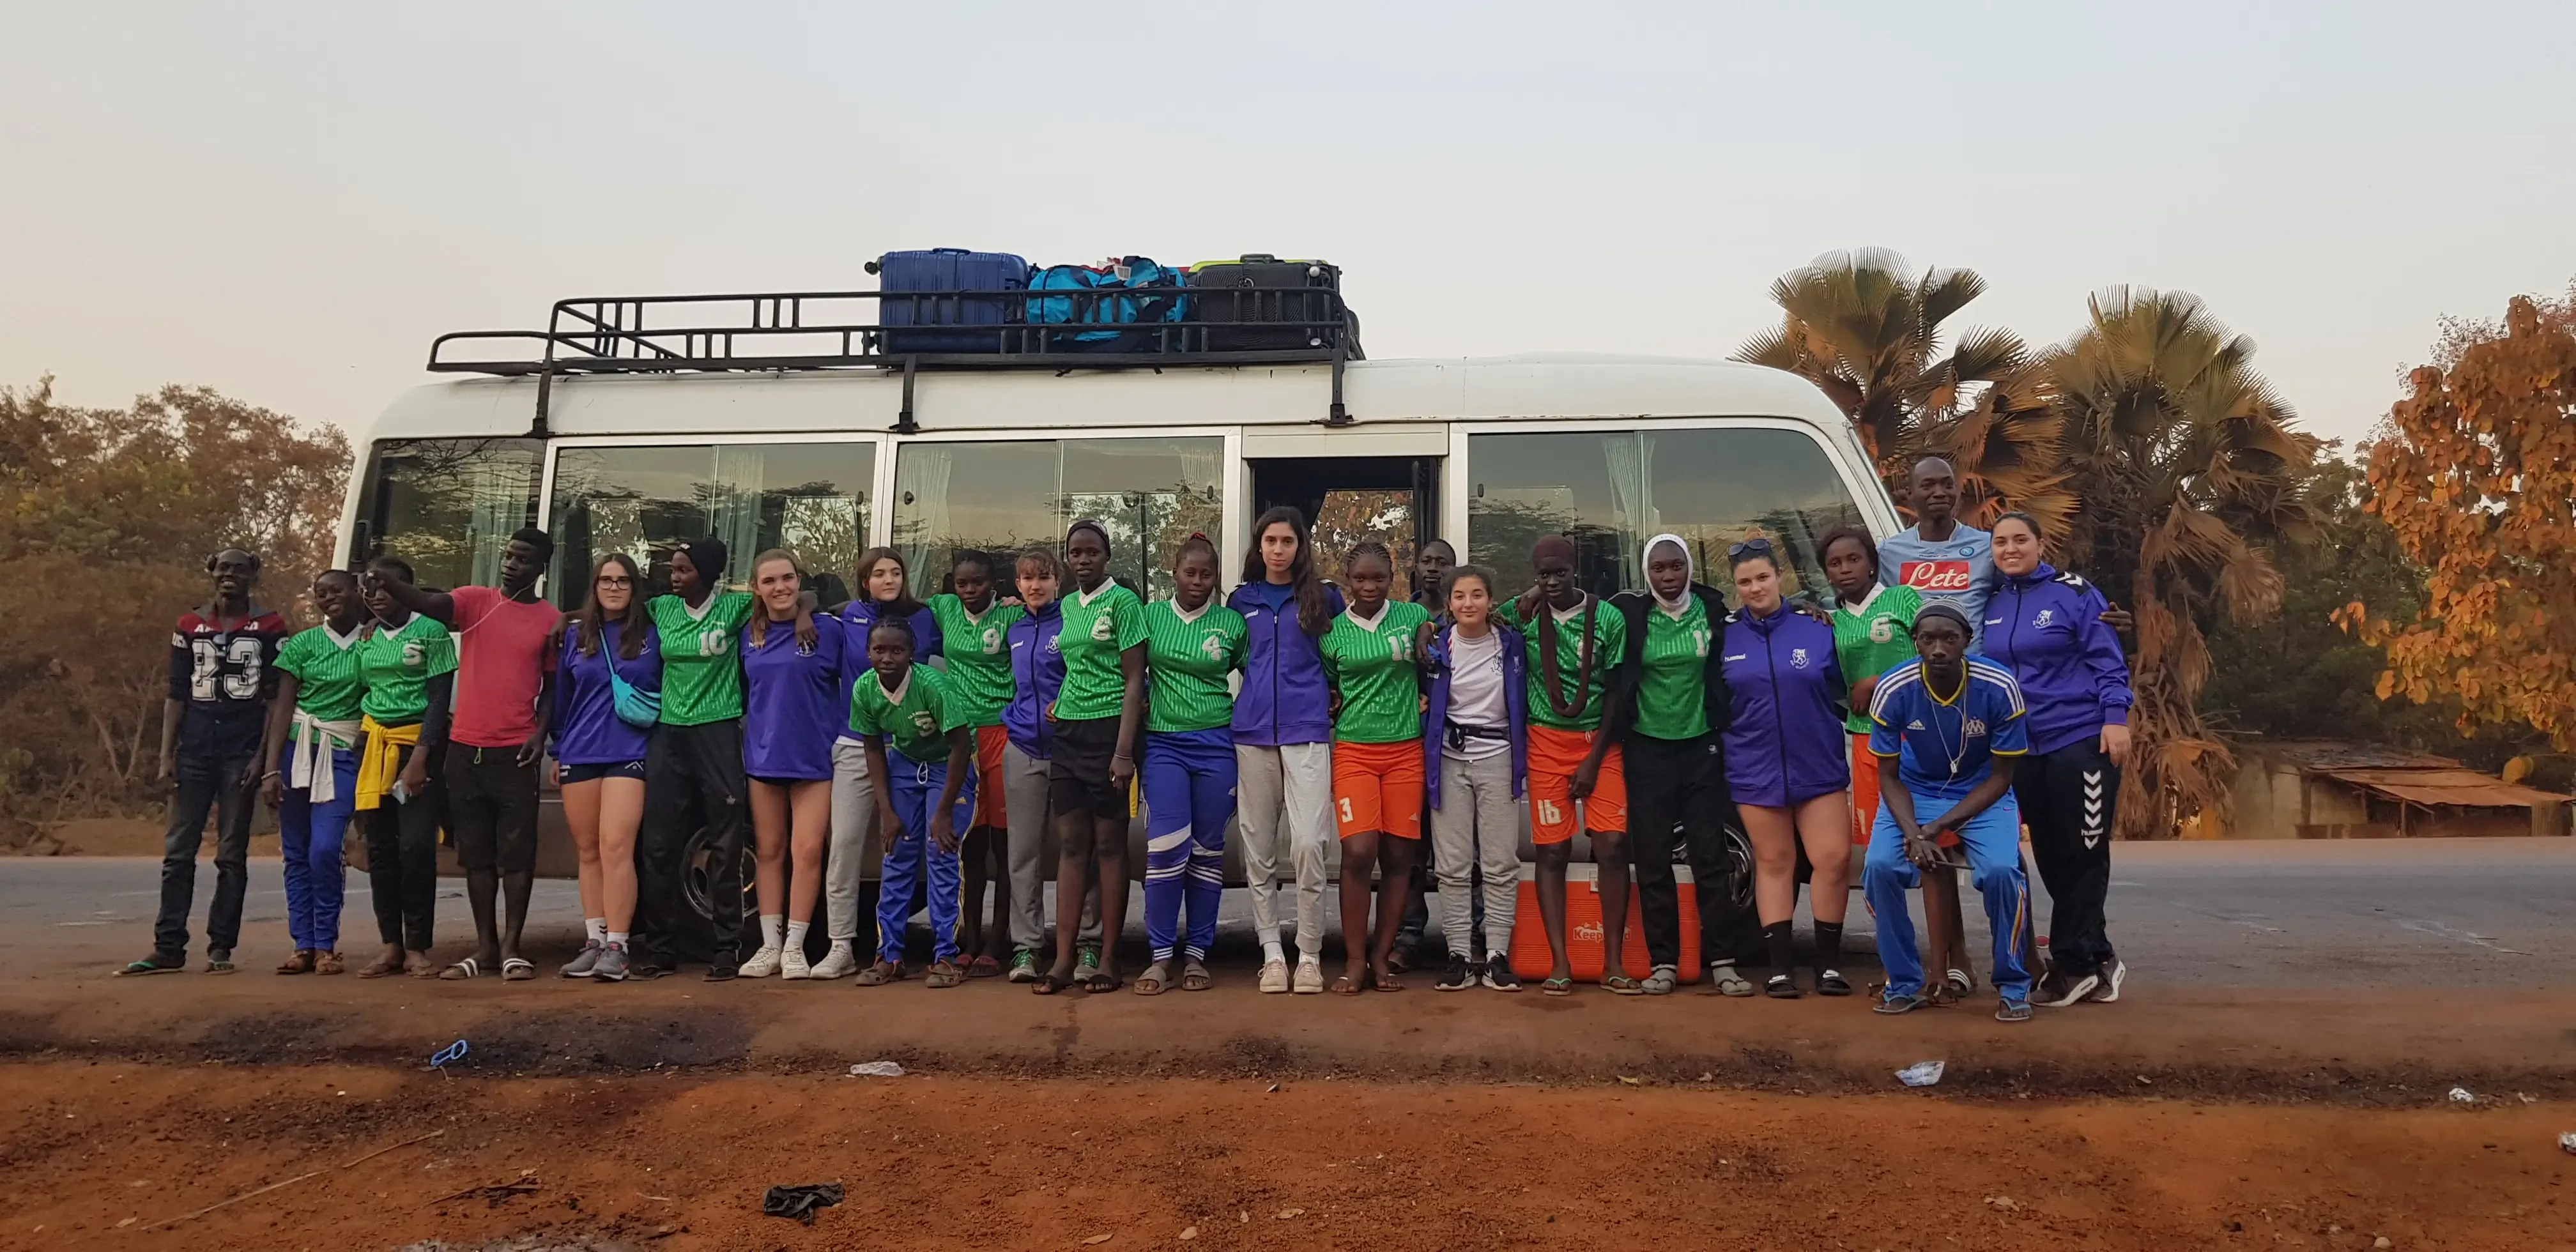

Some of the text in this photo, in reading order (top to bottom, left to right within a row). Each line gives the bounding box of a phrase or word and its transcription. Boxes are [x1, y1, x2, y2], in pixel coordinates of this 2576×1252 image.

[1906, 561, 1968, 590] Lete
[983, 628, 1000, 655] 9
[1869, 616, 1892, 643] 6
[1202, 635, 1222, 661] 4
[1724, 653, 1745, 662] hummel
[1339, 797, 1354, 823] 3
[1537, 799, 1561, 825] 16
[1574, 928, 1631, 943] Keepd
